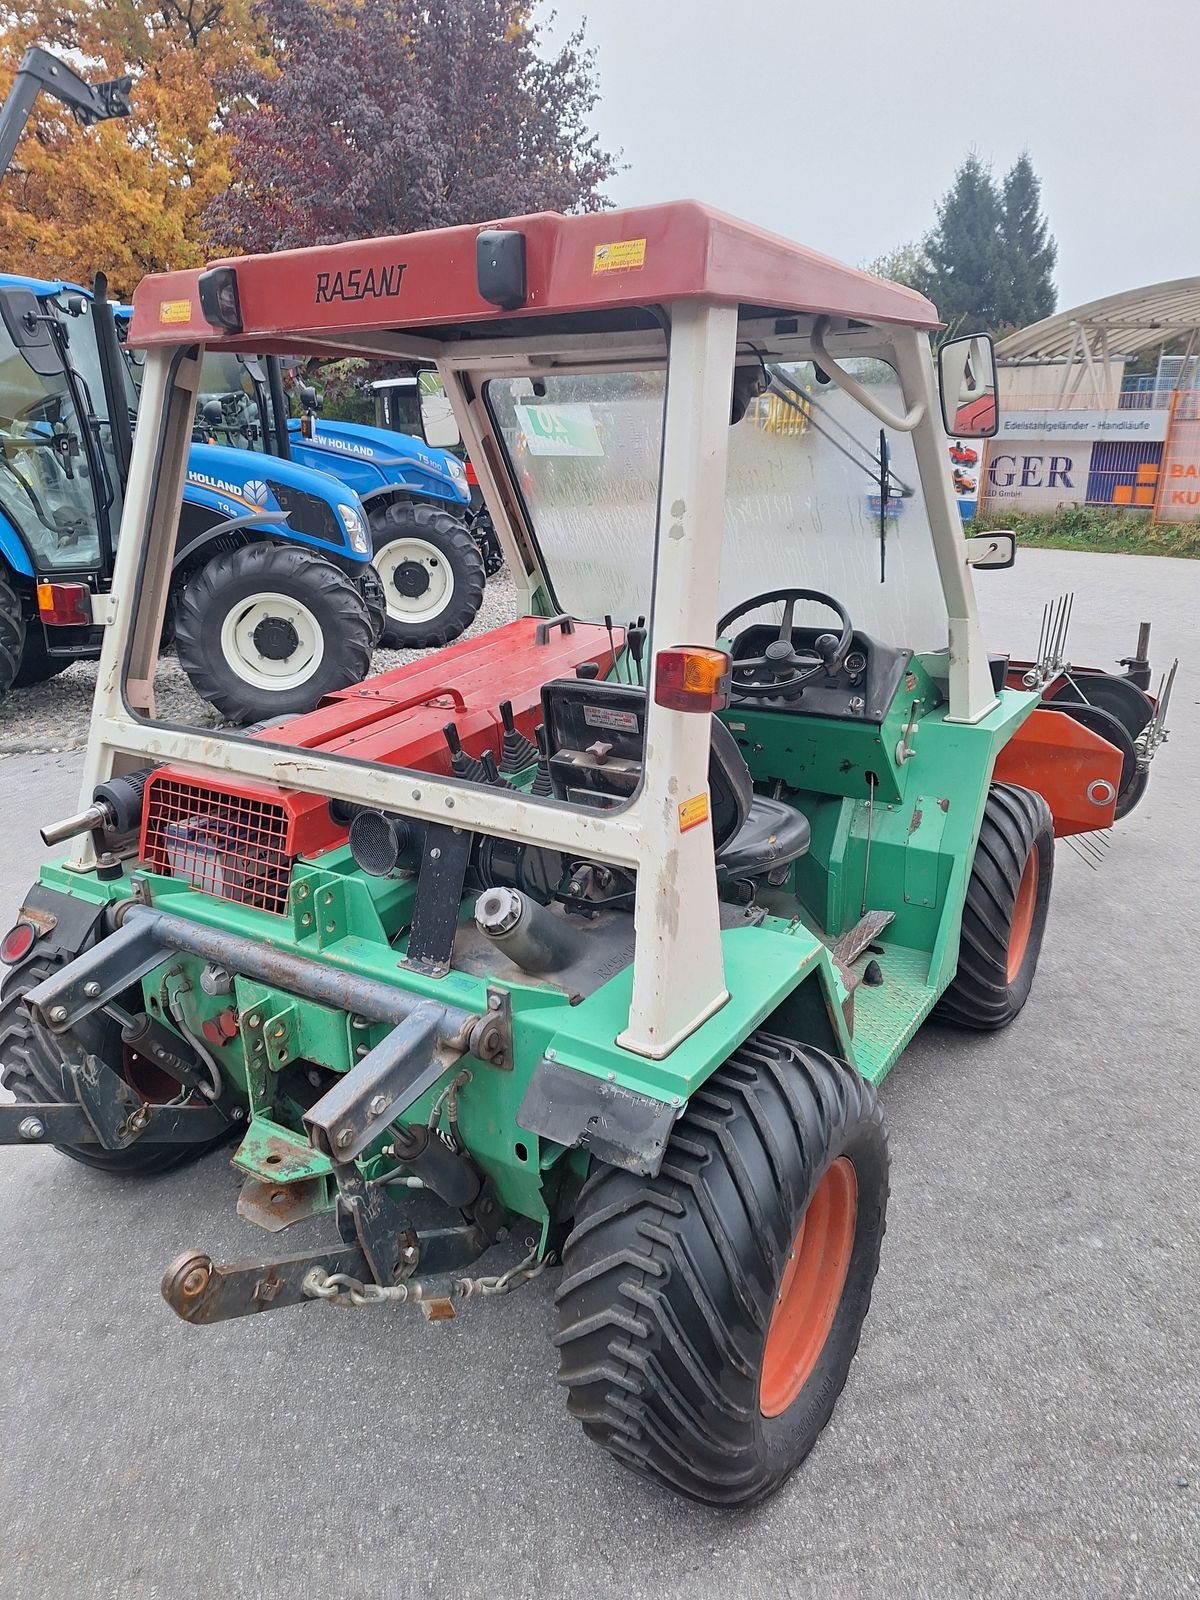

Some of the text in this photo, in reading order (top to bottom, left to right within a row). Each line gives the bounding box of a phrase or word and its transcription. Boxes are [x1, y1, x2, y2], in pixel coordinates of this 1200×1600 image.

[315, 264, 407, 303] RASANT
[1004, 420, 1089, 432] Edelstahlgeländer
[1097, 420, 1151, 430] Handläufe
[306, 434, 374, 457] EW HOLLAND
[188, 470, 243, 497] HOLLAND
[989, 455, 1075, 488] GER
[998, 489, 1024, 497] GmbH
